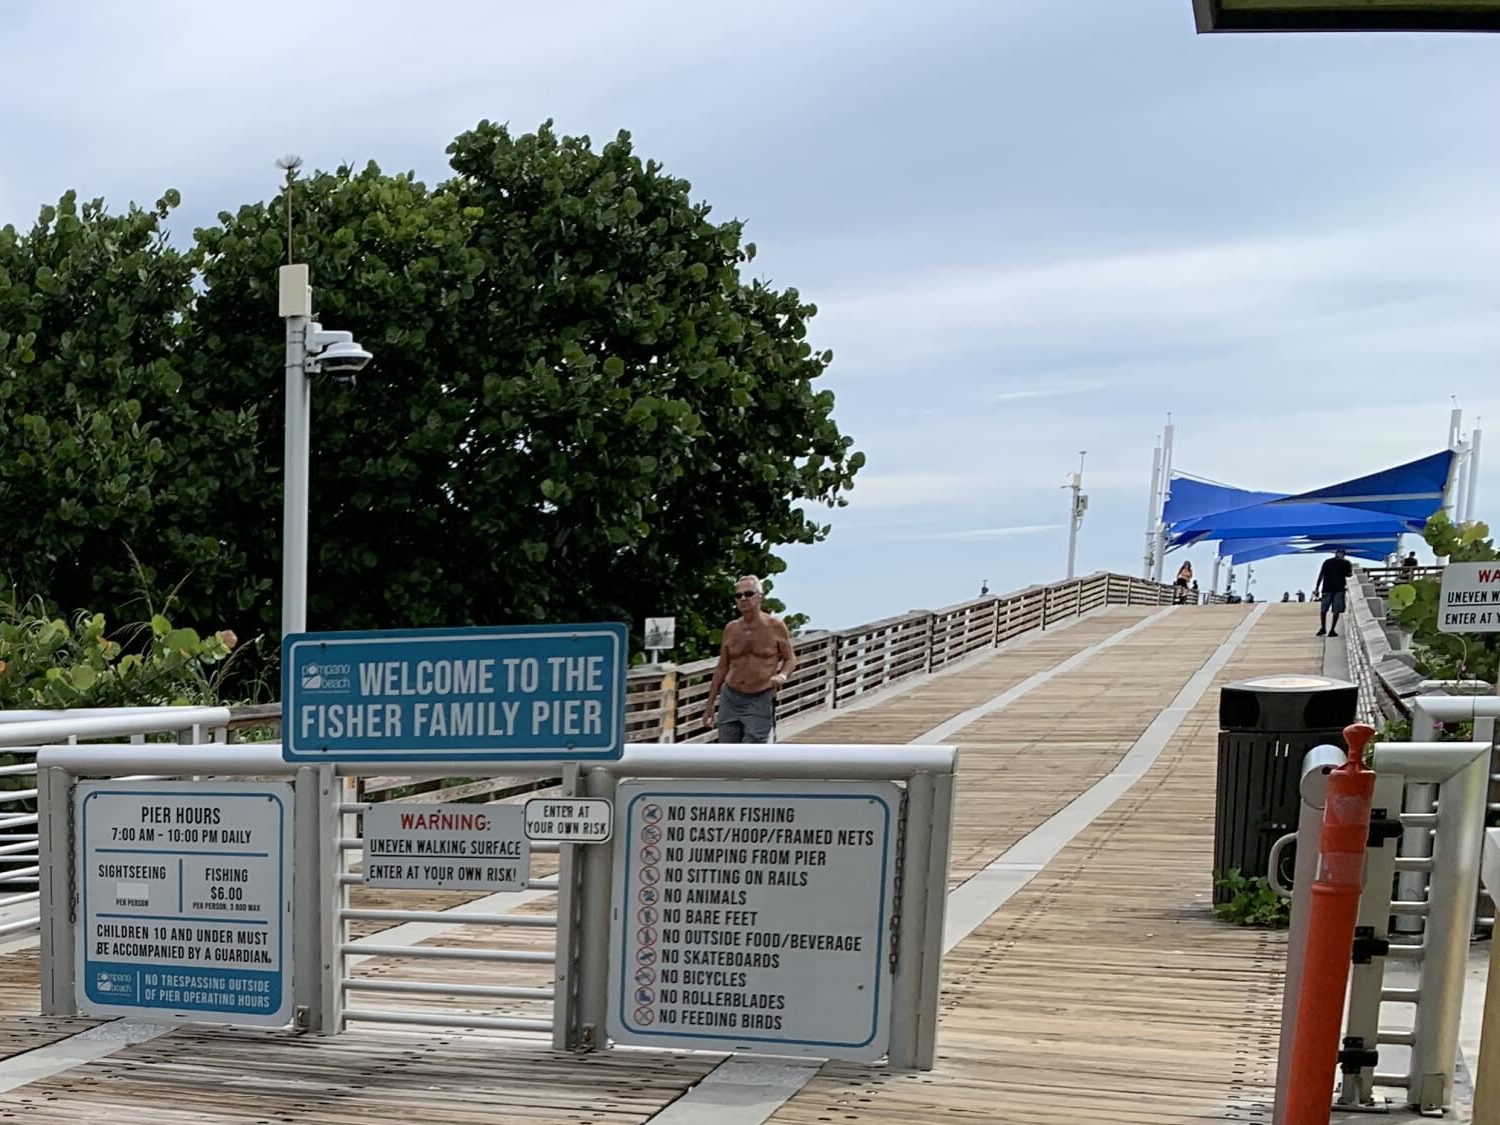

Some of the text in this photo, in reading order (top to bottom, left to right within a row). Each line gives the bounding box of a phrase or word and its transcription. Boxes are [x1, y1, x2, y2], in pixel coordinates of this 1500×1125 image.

[1448, 590, 1488, 603] UNEVEN
[1445, 612, 1476, 624] ENTER
[1480, 612, 1492, 624] AT
[359, 655, 605, 697] WELCOME TO THE
[301, 700, 602, 739] FISHER FAMILY PIER
[141, 806, 221, 825] PIER HOURS
[544, 805, 590, 818] ENTER AT
[668, 806, 795, 823] NO SHARK FISHING
[400, 812, 492, 832] WARNING:
[526, 821, 606, 836] YOUR OWN RISK
[111, 827, 135, 841] 7:00
[139, 828, 155, 841] AM
[167, 829, 198, 842] 10:00
[202, 830, 218, 843] PM
[221, 830, 252, 844] DAILY
[666, 827, 874, 846] NO CAST/HOOP/FRAMED NETS
[370, 838, 522, 856] UNEVEN WALKING SURFACE
[666, 848, 826, 866] NO JUMPING FROM PIER
[98, 864, 166, 880] SIGHTSEEING
[205, 868, 249, 882] FISHING
[369, 865, 517, 882] ENTER AT YOUR OWN RISK!
[665, 868, 808, 886] NO SITTING ON RAILS
[210, 886, 243, 901] $6.00
[664, 888, 746, 905] NO ANIMALS
[128, 898, 149, 908] PERSON
[663, 908, 758, 926] NO BARE FEET
[96, 924, 268, 946] CHILDREN 10 AND UNDER MUST
[662, 929, 862, 952] NO OUTSIDE FOOD/BEVERAGE
[96, 942, 110, 955] BE
[113, 942, 185, 960] ACCOMPANIED
[188, 946, 201, 960] BY
[204, 947, 212, 960] A
[661, 949, 780, 968] NO SKATEBOARDS
[145, 973, 270, 993] NO TRESPASSING OUTSIDE
[660, 969, 746, 987] NO BICYCLES
[145, 988, 270, 1008] OF PIER OPERATING HOURS
[660, 989, 785, 1010] NO ROLLERBLADES
[659, 1009, 782, 1030] NO FEEDING BIRDS
